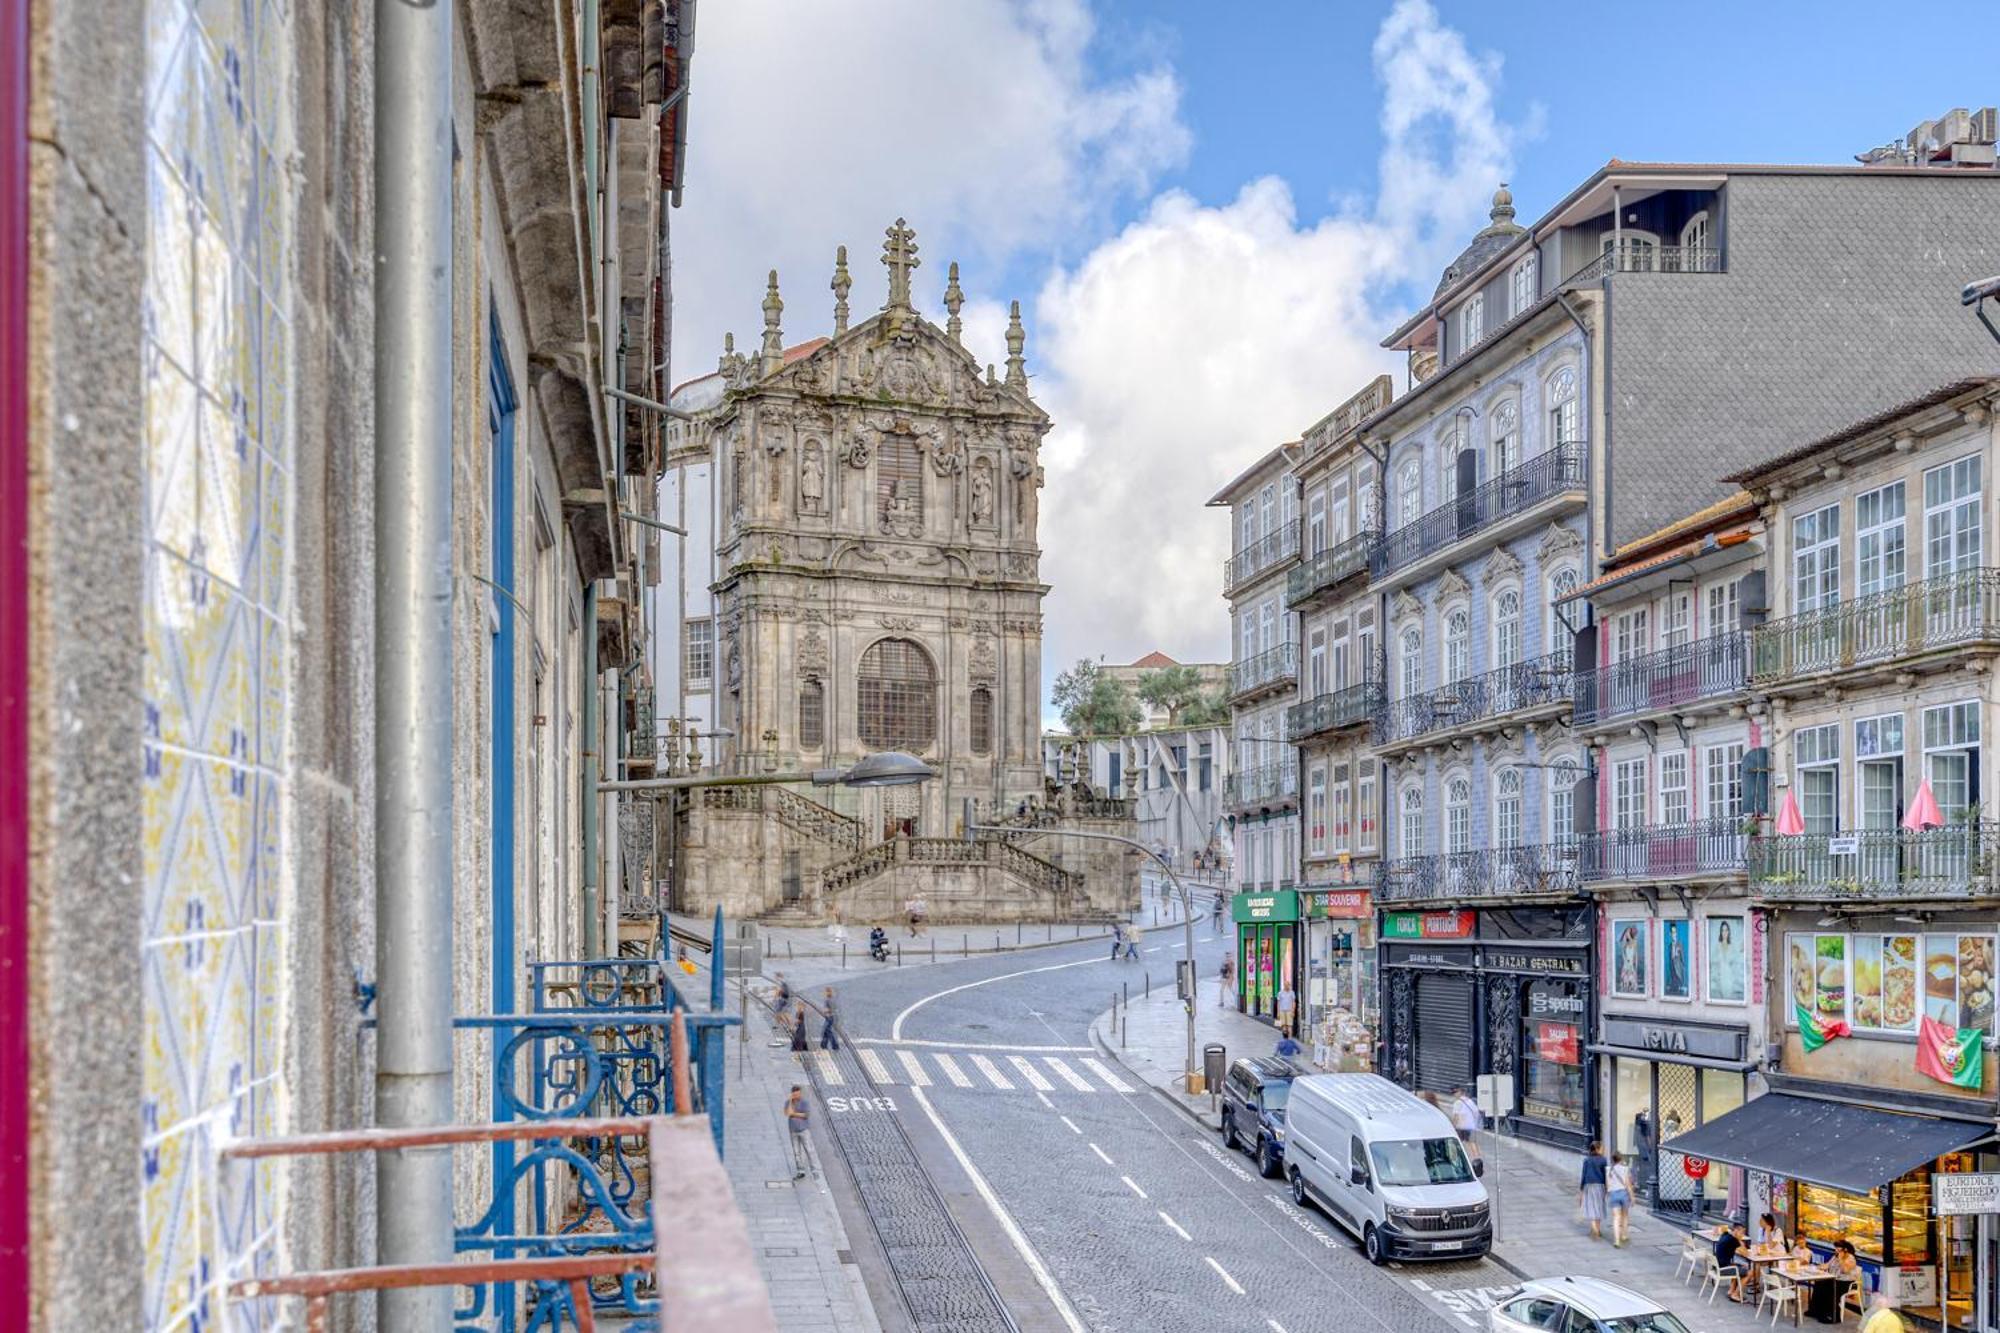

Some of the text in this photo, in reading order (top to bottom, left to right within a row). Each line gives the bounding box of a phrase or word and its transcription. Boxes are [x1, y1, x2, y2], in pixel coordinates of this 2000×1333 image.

[1315, 893, 1361, 906] STAR SOUVENIR
[1396, 916, 1460, 935] FORÇA PORTUGAL
[1499, 955, 1527, 969] BAZAR
[1530, 958, 1570, 971] CENTRAL
[826, 1096, 898, 1112] BUS
